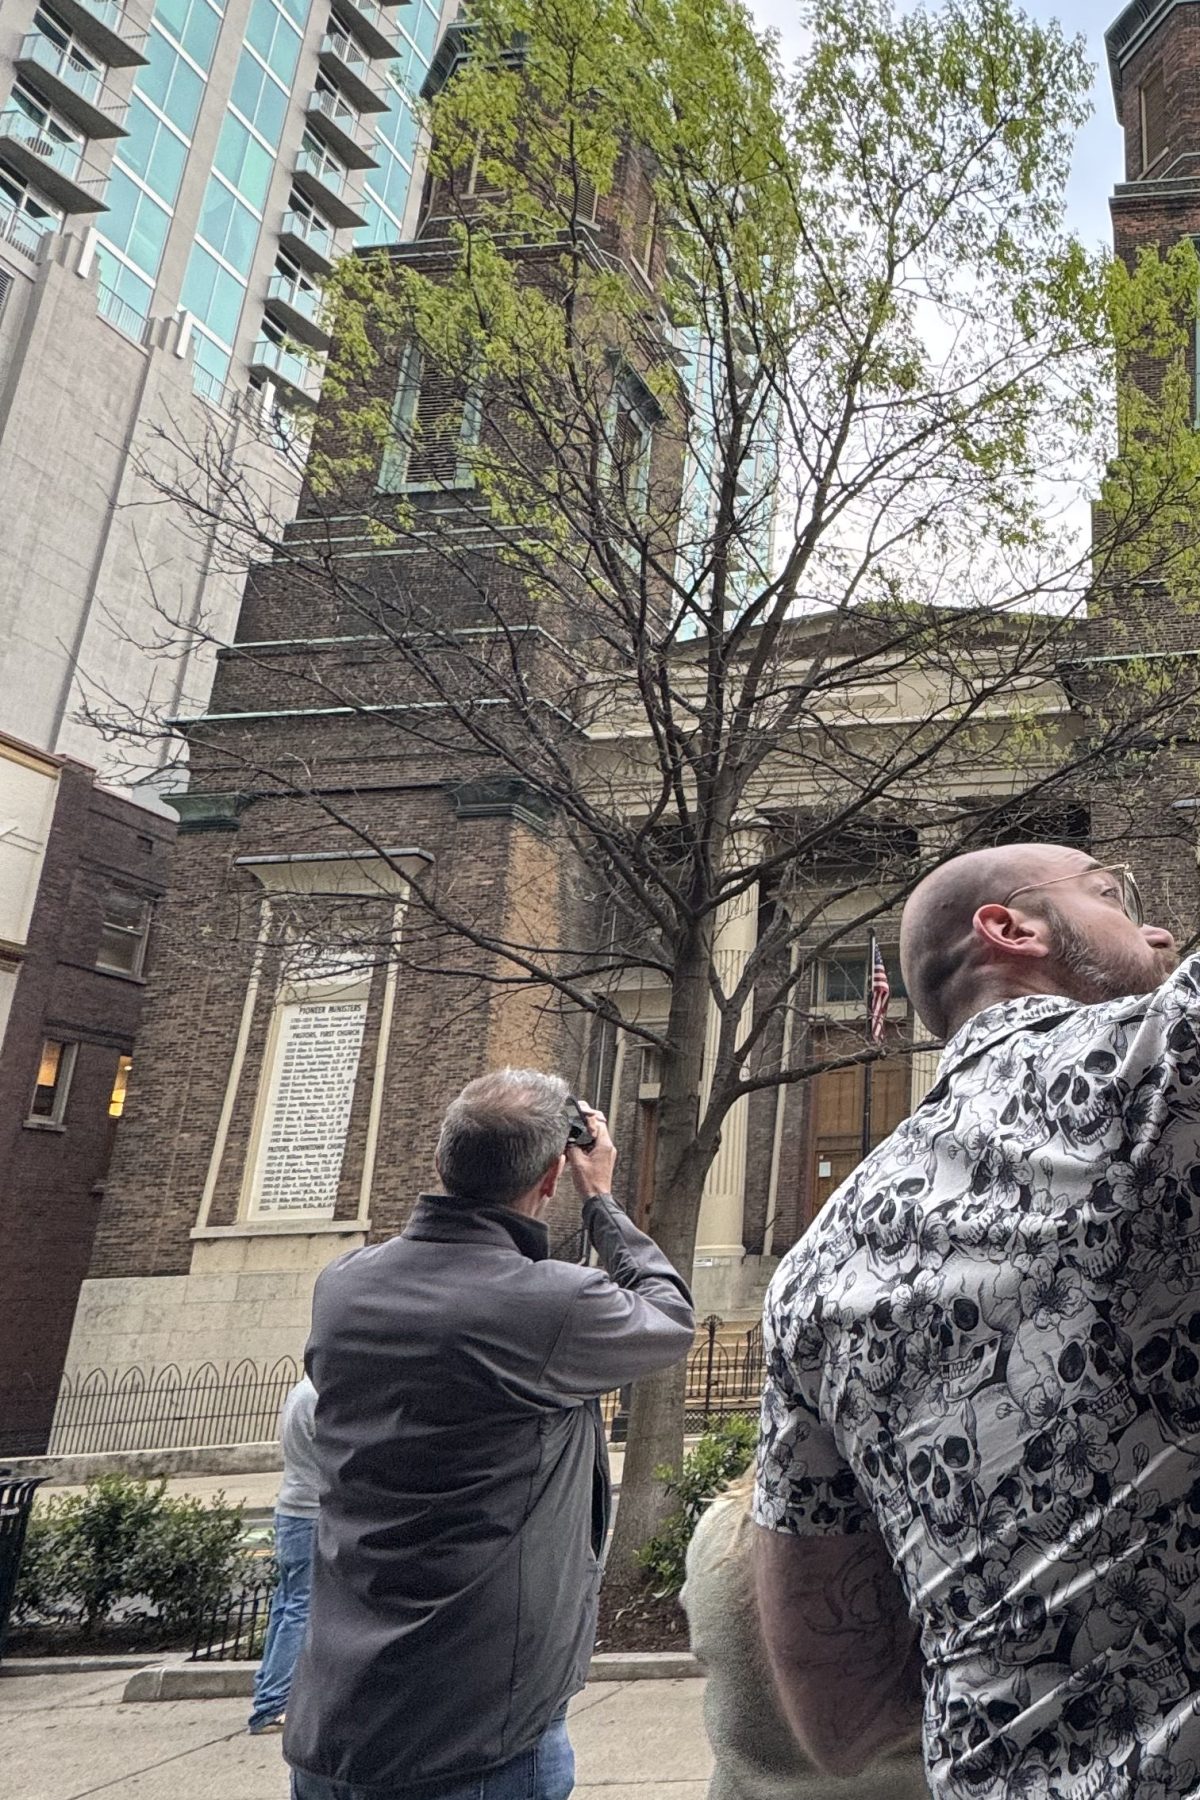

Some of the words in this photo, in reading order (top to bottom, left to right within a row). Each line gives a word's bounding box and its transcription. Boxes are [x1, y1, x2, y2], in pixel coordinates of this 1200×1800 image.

[299, 1006, 326, 1015] PIONEER
[328, 1004, 362, 1013] MINISTERS
[292, 1144, 325, 1152] DOWNTOWN
